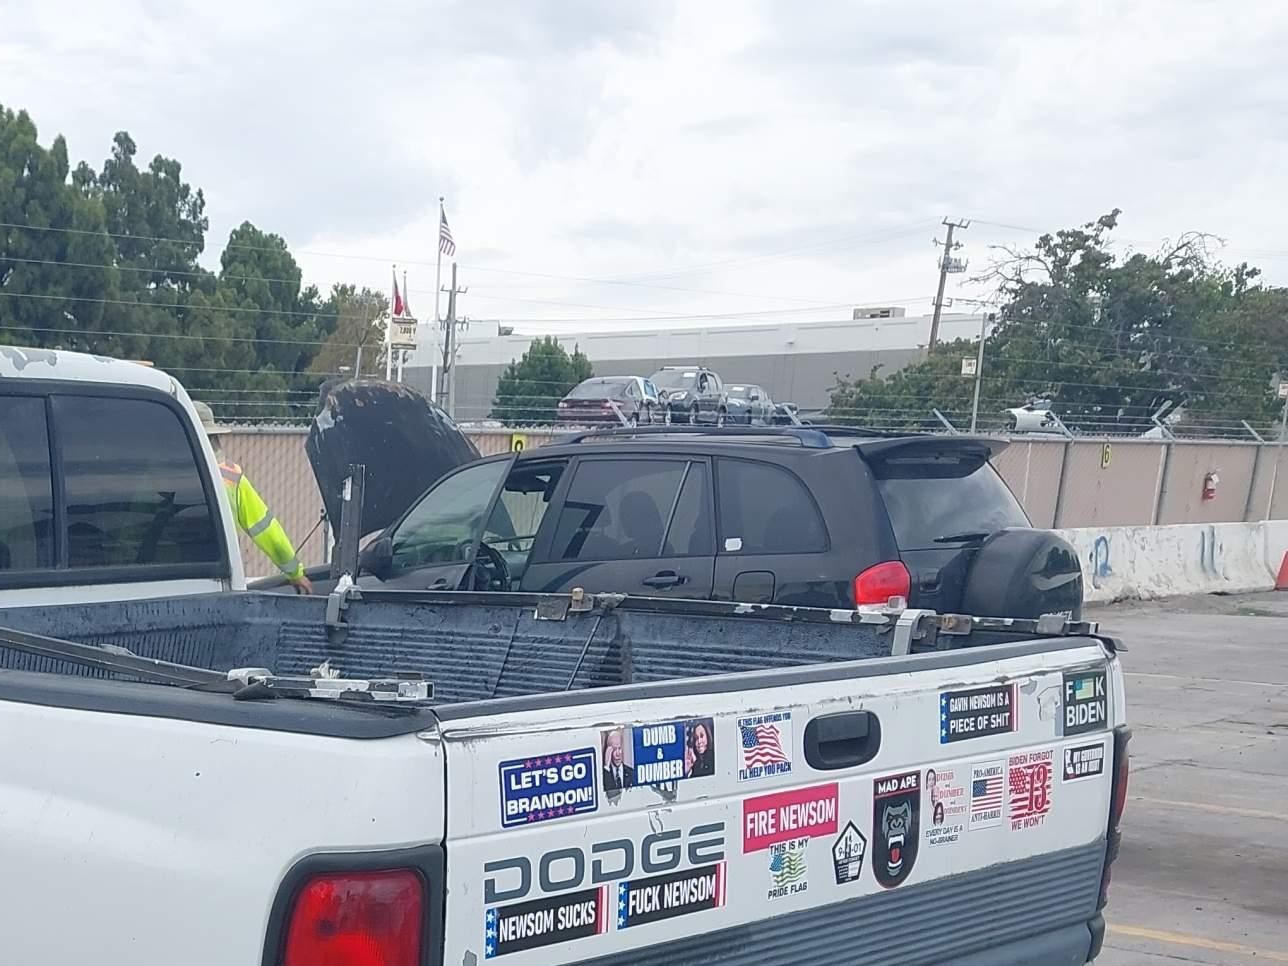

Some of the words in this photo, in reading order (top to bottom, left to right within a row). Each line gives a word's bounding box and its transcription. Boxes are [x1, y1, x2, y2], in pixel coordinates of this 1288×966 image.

[950, 697, 968, 712] GAVIN
[969, 693, 996, 711] NEWSOM
[997, 692, 1004, 706] IS
[1005, 691, 1010, 705] A
[753, 715, 763, 725] FLAG
[783, 711, 791, 720] YOU
[950, 717, 975, 735] PIECE
[977, 715, 989, 730] OF
[991, 712, 1010, 728] SHIT
[1066, 700, 1105, 727] BIDEN
[642, 725, 676, 747] DUMB
[656, 748, 664, 760] &
[1009, 755, 1028, 766] BIDEN
[1029, 750, 1053, 762] FORGOT
[510, 766, 559, 791] LET'S
[561, 762, 586, 781] GO
[637, 759, 684, 784] DUMBER
[749, 765, 763, 778] HELP
[764, 763, 775, 776] YOU
[777, 761, 792, 774] PACK
[973, 766, 1003, 778] PRO-AMERICA
[878, 780, 898, 794] MAD
[900, 775, 917, 789] APE
[1028, 764, 1047, 811] 13
[506, 786, 593, 816] BRANDON!
[746, 808, 777, 839] FIRE
[779, 797, 836, 831] NEWSOM
[971, 809, 1000, 822] ANTI-HARRIS
[1011, 820, 1021, 831] WE
[926, 827, 942, 838] EVERY
[943, 825, 953, 835] DAY
[954, 825, 958, 833] IS
[770, 842, 786, 855] THIS
[789, 840, 795, 851] IS
[798, 837, 810, 849] MY
[484, 822, 725, 904] DODGE
[628, 885, 660, 917] FUCK
[663, 873, 716, 909] NEWSOM
[768, 886, 788, 899] PRIDE
[791, 882, 808, 894] FLAG
[499, 908, 554, 943] NEWSOM
[557, 900, 596, 930] SUCKS
